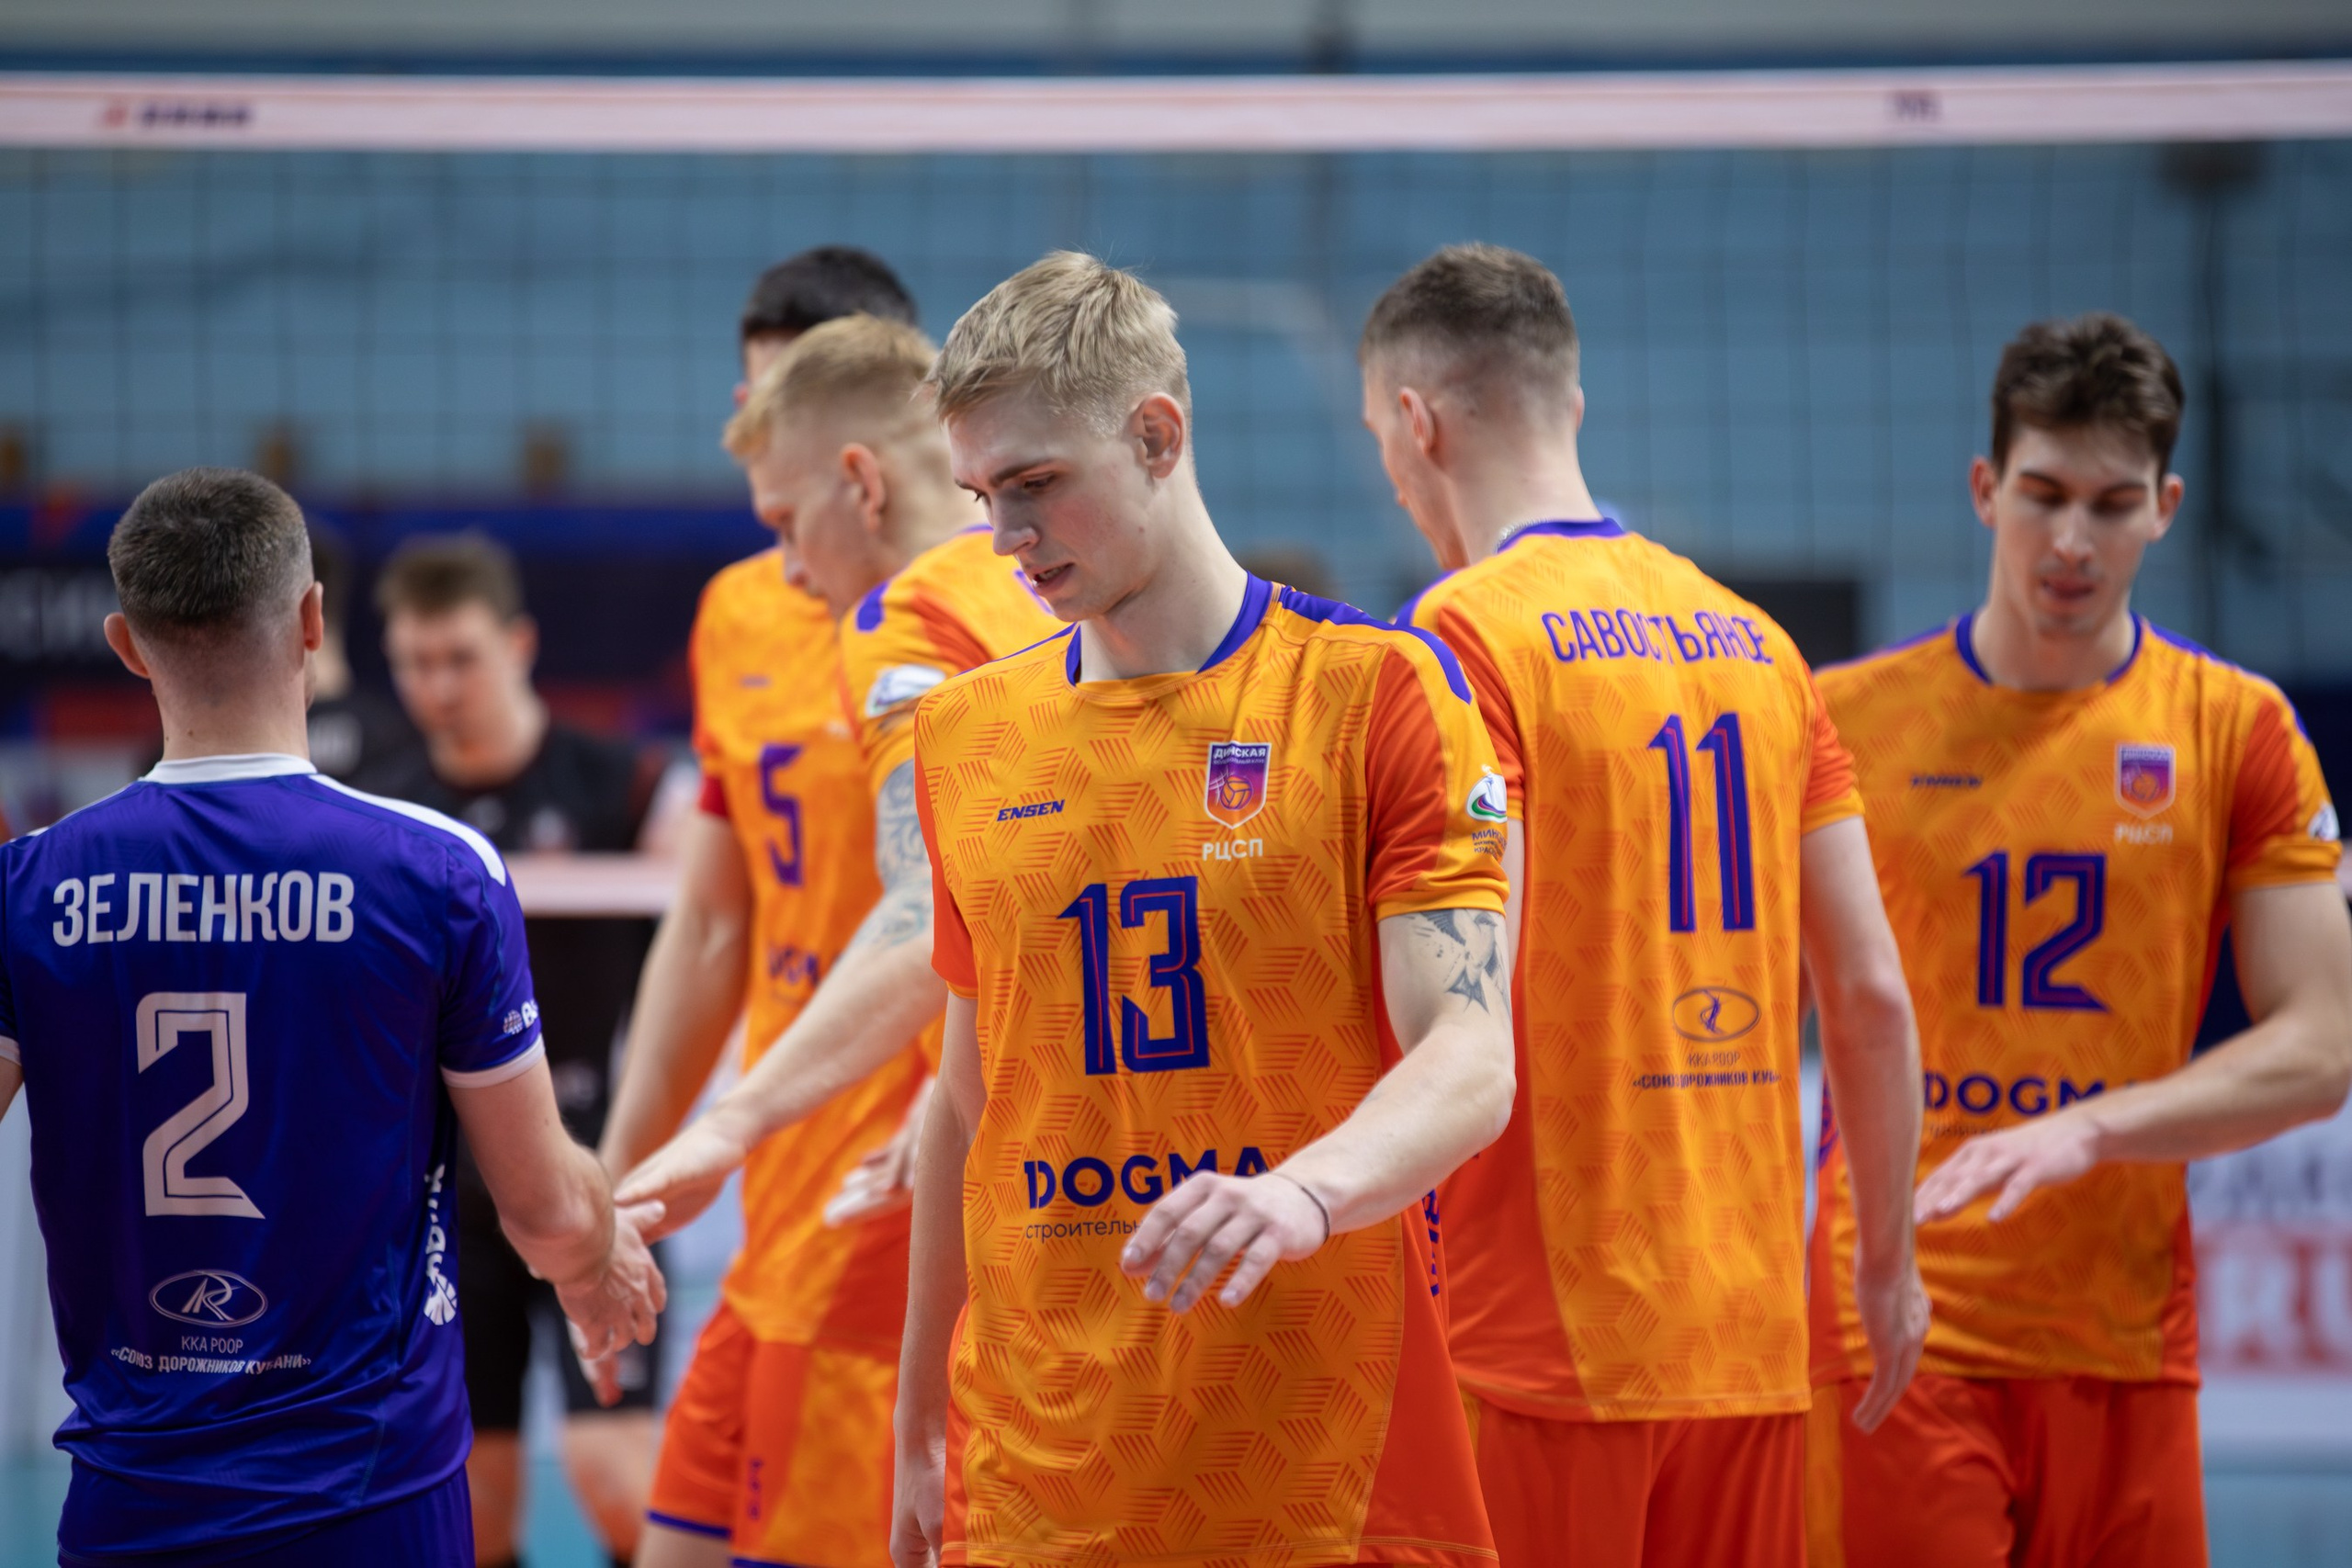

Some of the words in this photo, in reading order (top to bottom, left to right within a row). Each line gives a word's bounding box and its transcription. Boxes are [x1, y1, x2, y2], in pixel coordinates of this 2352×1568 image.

[1213, 745, 1267, 760] ДИНСКАЯ
[758, 742, 806, 886] 5
[997, 798, 1065, 822] ENSEN
[1647, 712, 1756, 932] 11
[1203, 838, 1264, 862] РЦСП
[52, 870, 355, 947] ЗЕЛЕНКОВ
[1961, 850, 2110, 1011] 12
[1056, 875, 1210, 1075] 13
[136, 991, 266, 1219] 2
[1923, 1070, 2135, 1116] DOGM
[158, 1355, 245, 1374] ДОРОЖНИКОВ
[181, 1336, 208, 1352] ККА
[210, 1337, 243, 1354] РООР
